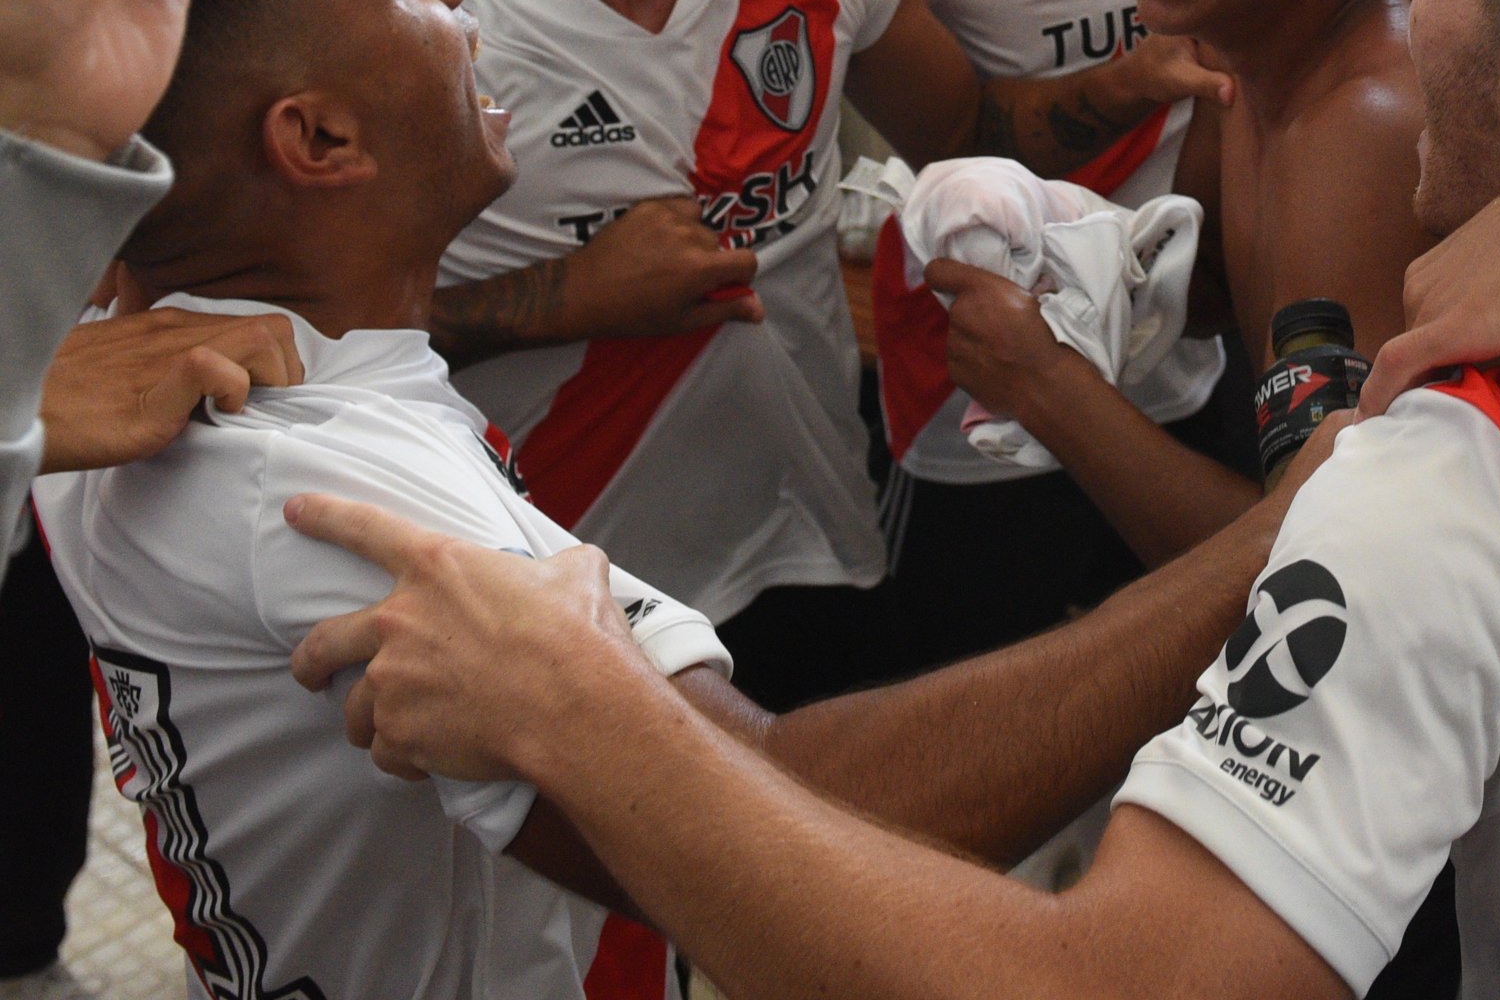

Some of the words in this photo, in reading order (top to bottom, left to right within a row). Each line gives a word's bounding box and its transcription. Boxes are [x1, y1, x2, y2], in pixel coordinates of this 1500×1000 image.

[1042, 5, 1148, 68] TUR
[551, 126, 636, 149] adidas
[1187, 702, 1321, 782] AXION
[1219, 756, 1296, 807] energy
